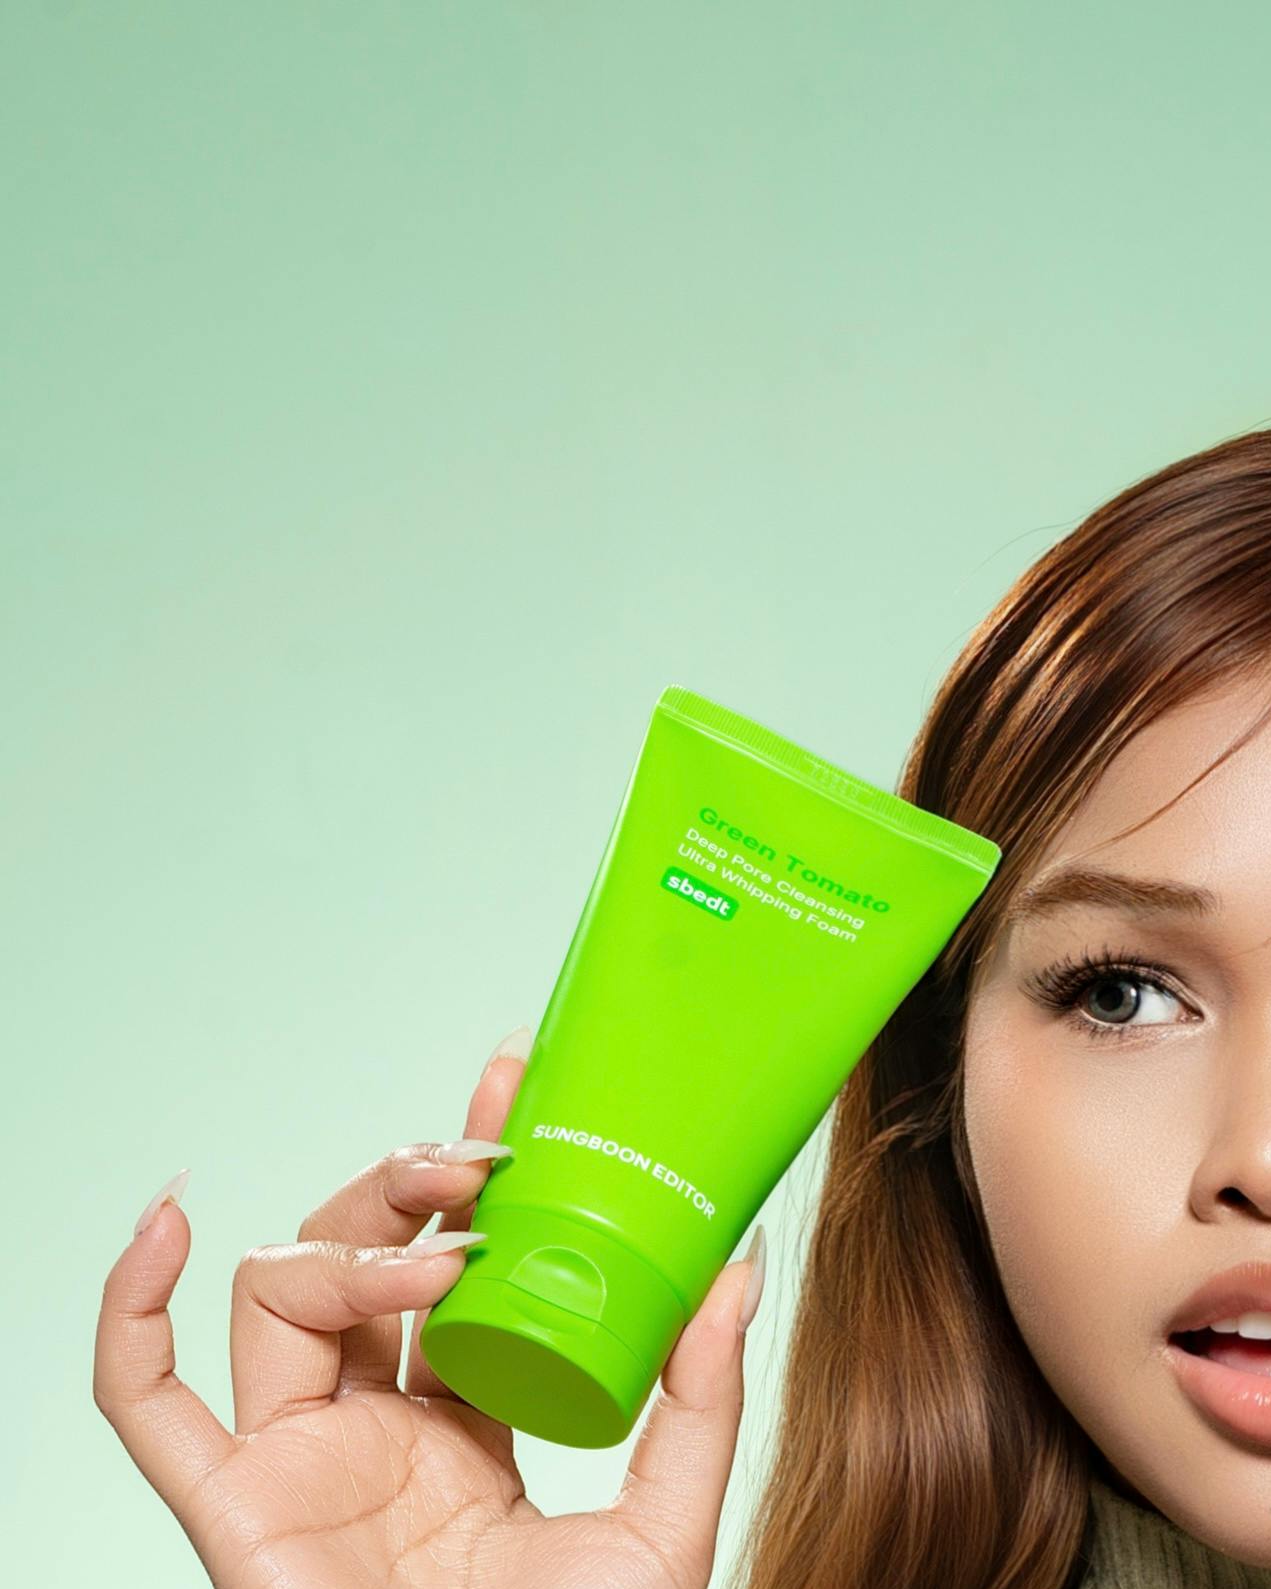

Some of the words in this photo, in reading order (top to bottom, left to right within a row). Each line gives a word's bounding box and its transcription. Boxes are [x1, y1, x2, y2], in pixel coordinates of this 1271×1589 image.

[667, 873, 731, 916] sbedt
[677, 843, 717, 873] Ultra
[721, 867, 802, 920] Whipping
[806, 914, 857, 943] Foam
[686, 828, 728, 859] Deep
[731, 854, 772, 884] Pore
[776, 880, 865, 930] Cleansing
[699, 807, 776, 861] Green
[786, 854, 890, 913] Tomato
[532, 1124, 651, 1171] SUNGBOON
[652, 1163, 716, 1220] EDITOR
